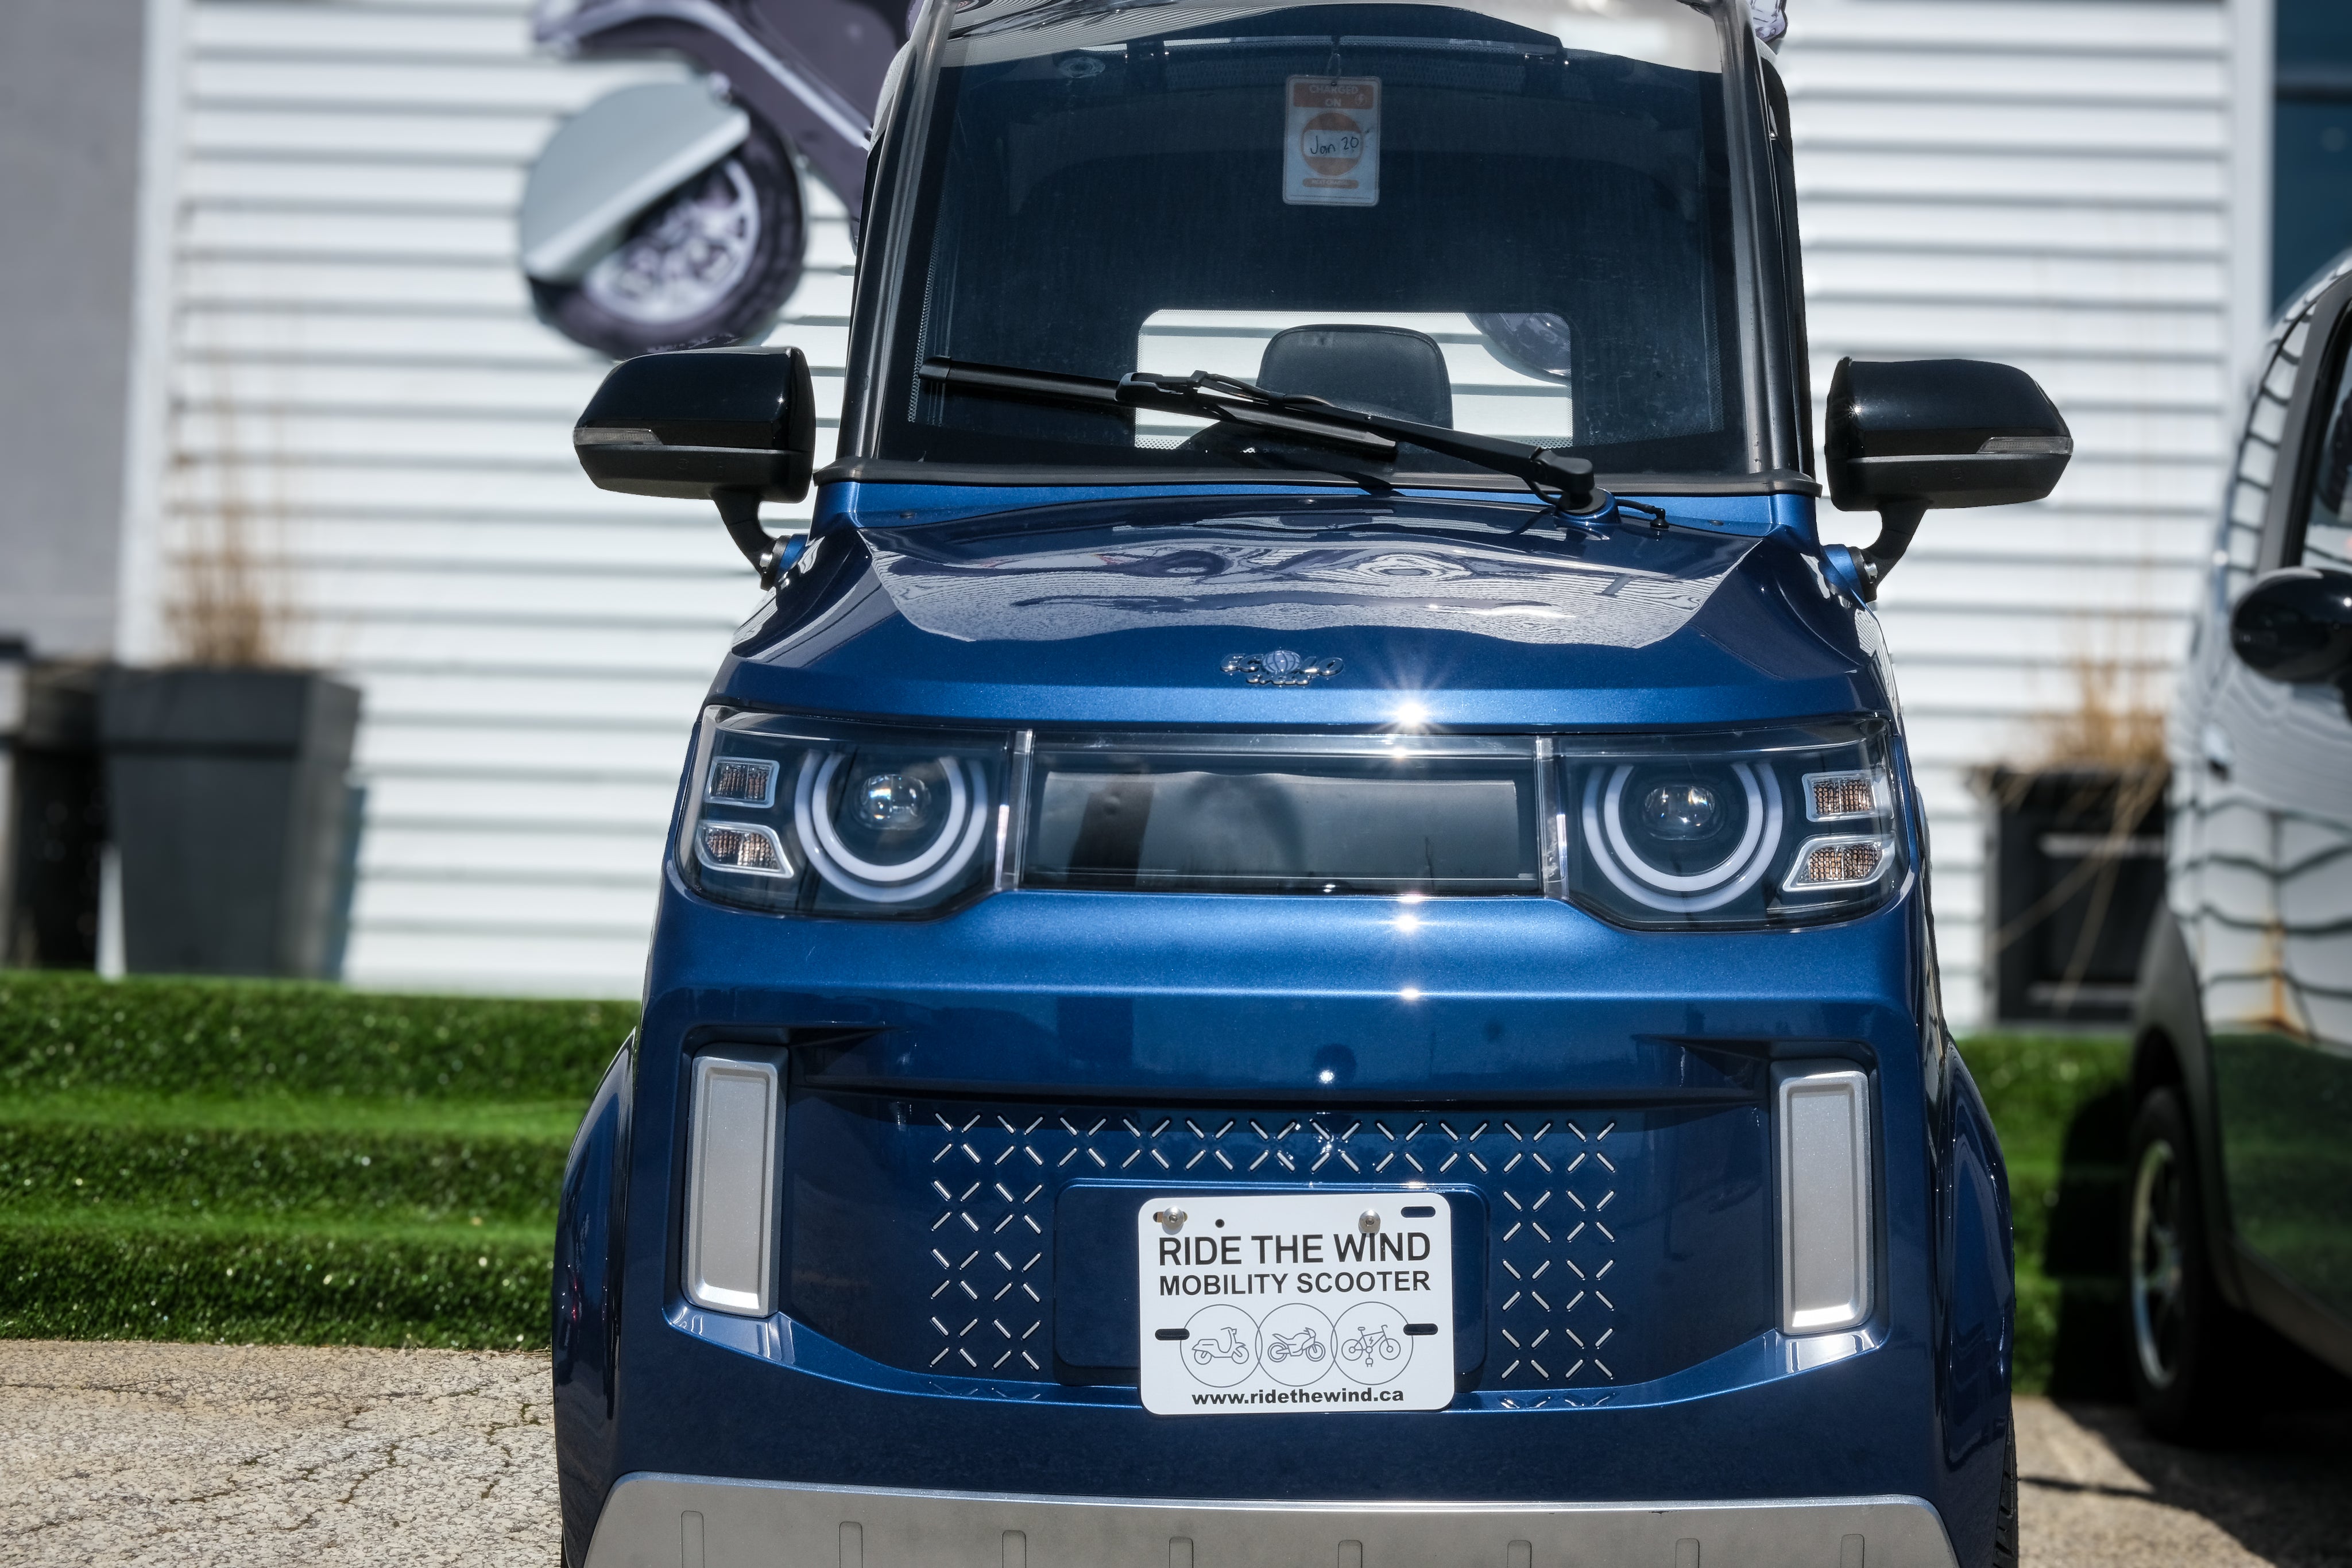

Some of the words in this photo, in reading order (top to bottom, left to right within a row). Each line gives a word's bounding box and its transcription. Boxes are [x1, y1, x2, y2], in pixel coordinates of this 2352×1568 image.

[1309, 86, 1359, 95] CHARGED
[1325, 98, 1342, 107] ON
[1310, 135, 1336, 154] Jan
[1341, 136, 1360, 150] 20
[1159, 1236, 1242, 1266] RIDE
[1251, 1234, 1324, 1264] THE
[1333, 1232, 1431, 1262] WIND
[1159, 1273, 1289, 1296] MOBILITY
[1297, 1270, 1432, 1294] SCOOTER
[1192, 1388, 1405, 1406] www.ridethewind.ca
